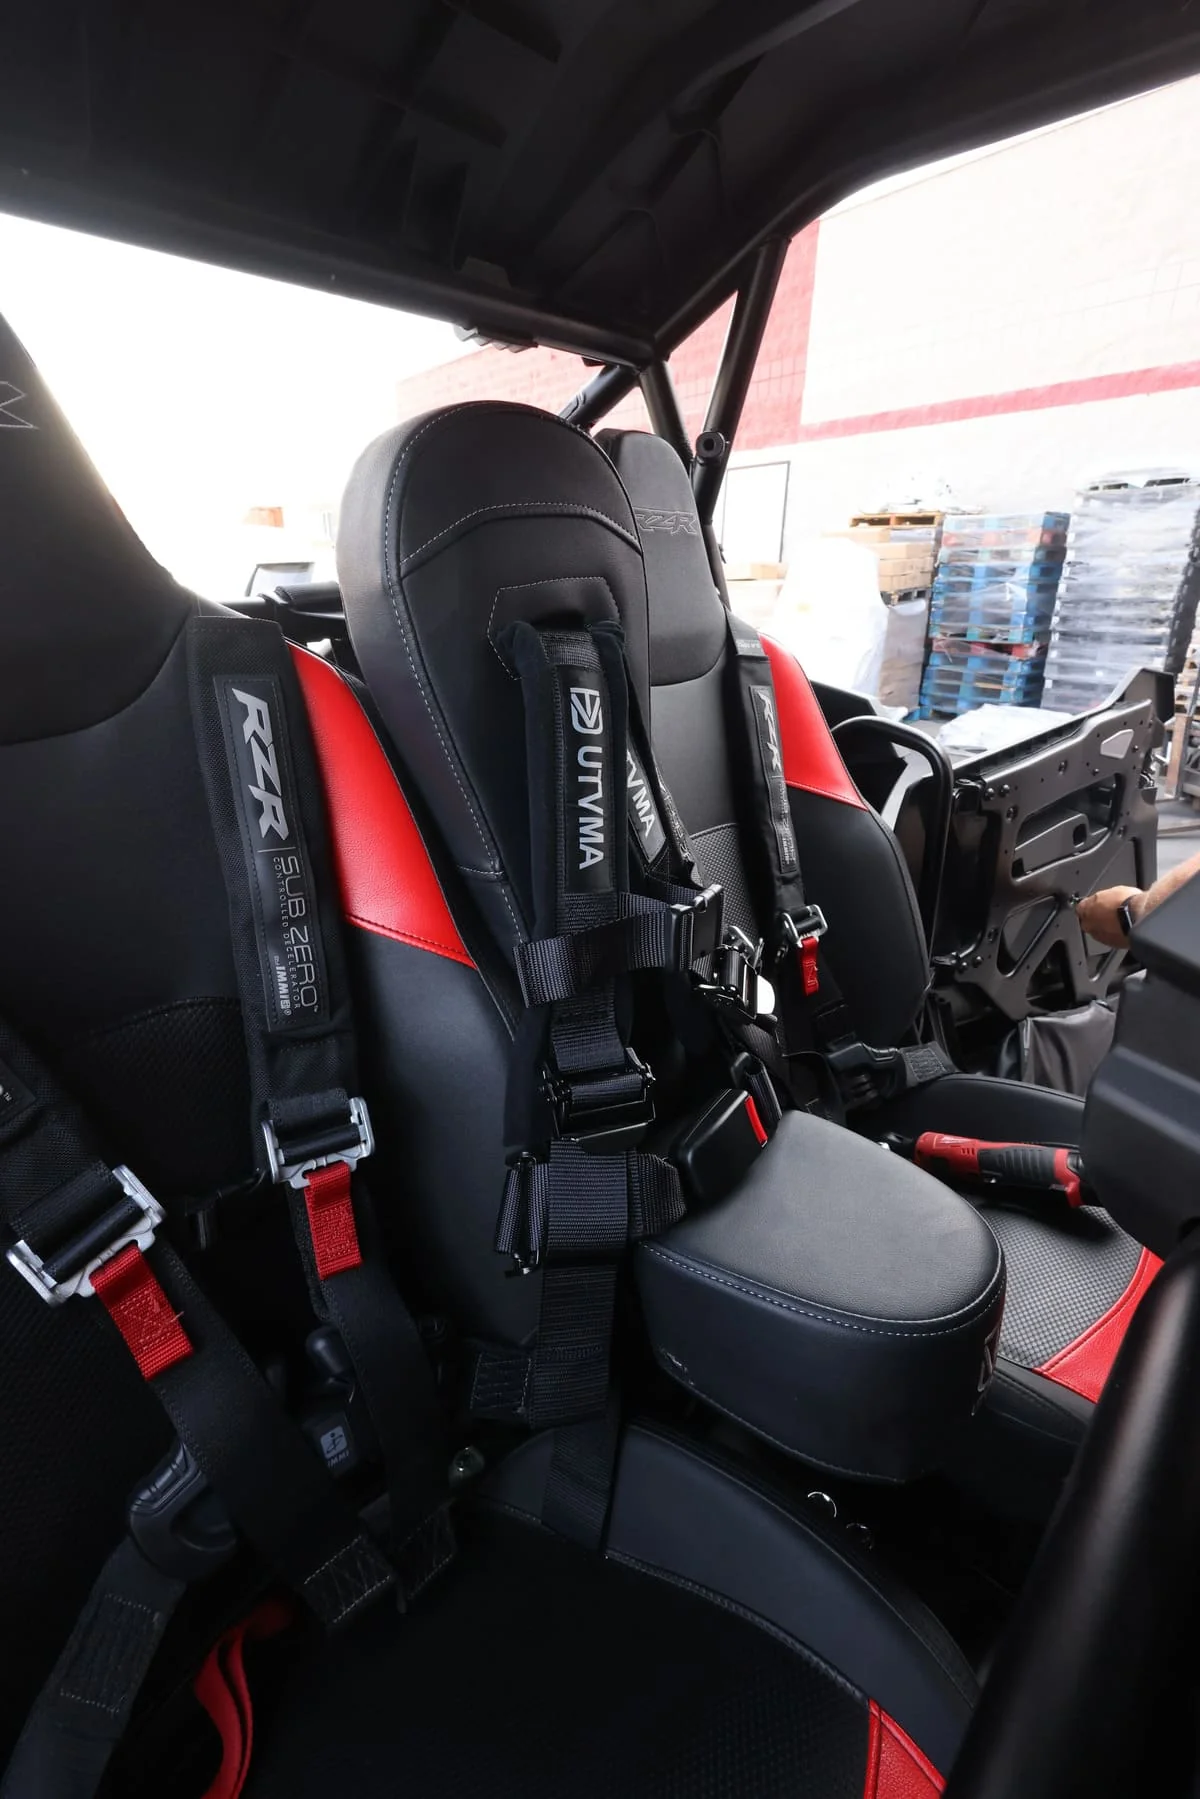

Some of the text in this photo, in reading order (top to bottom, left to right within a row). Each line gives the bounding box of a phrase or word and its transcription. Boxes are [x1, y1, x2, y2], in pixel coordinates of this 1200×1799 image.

[232, 688, 289, 840] RZR
[577, 745, 605, 870] UTVMA
[627, 748, 655, 839] VMA
[273, 856, 301, 1009] CONTROLLED DECELERATOR
[280, 856, 306, 918] SUB
